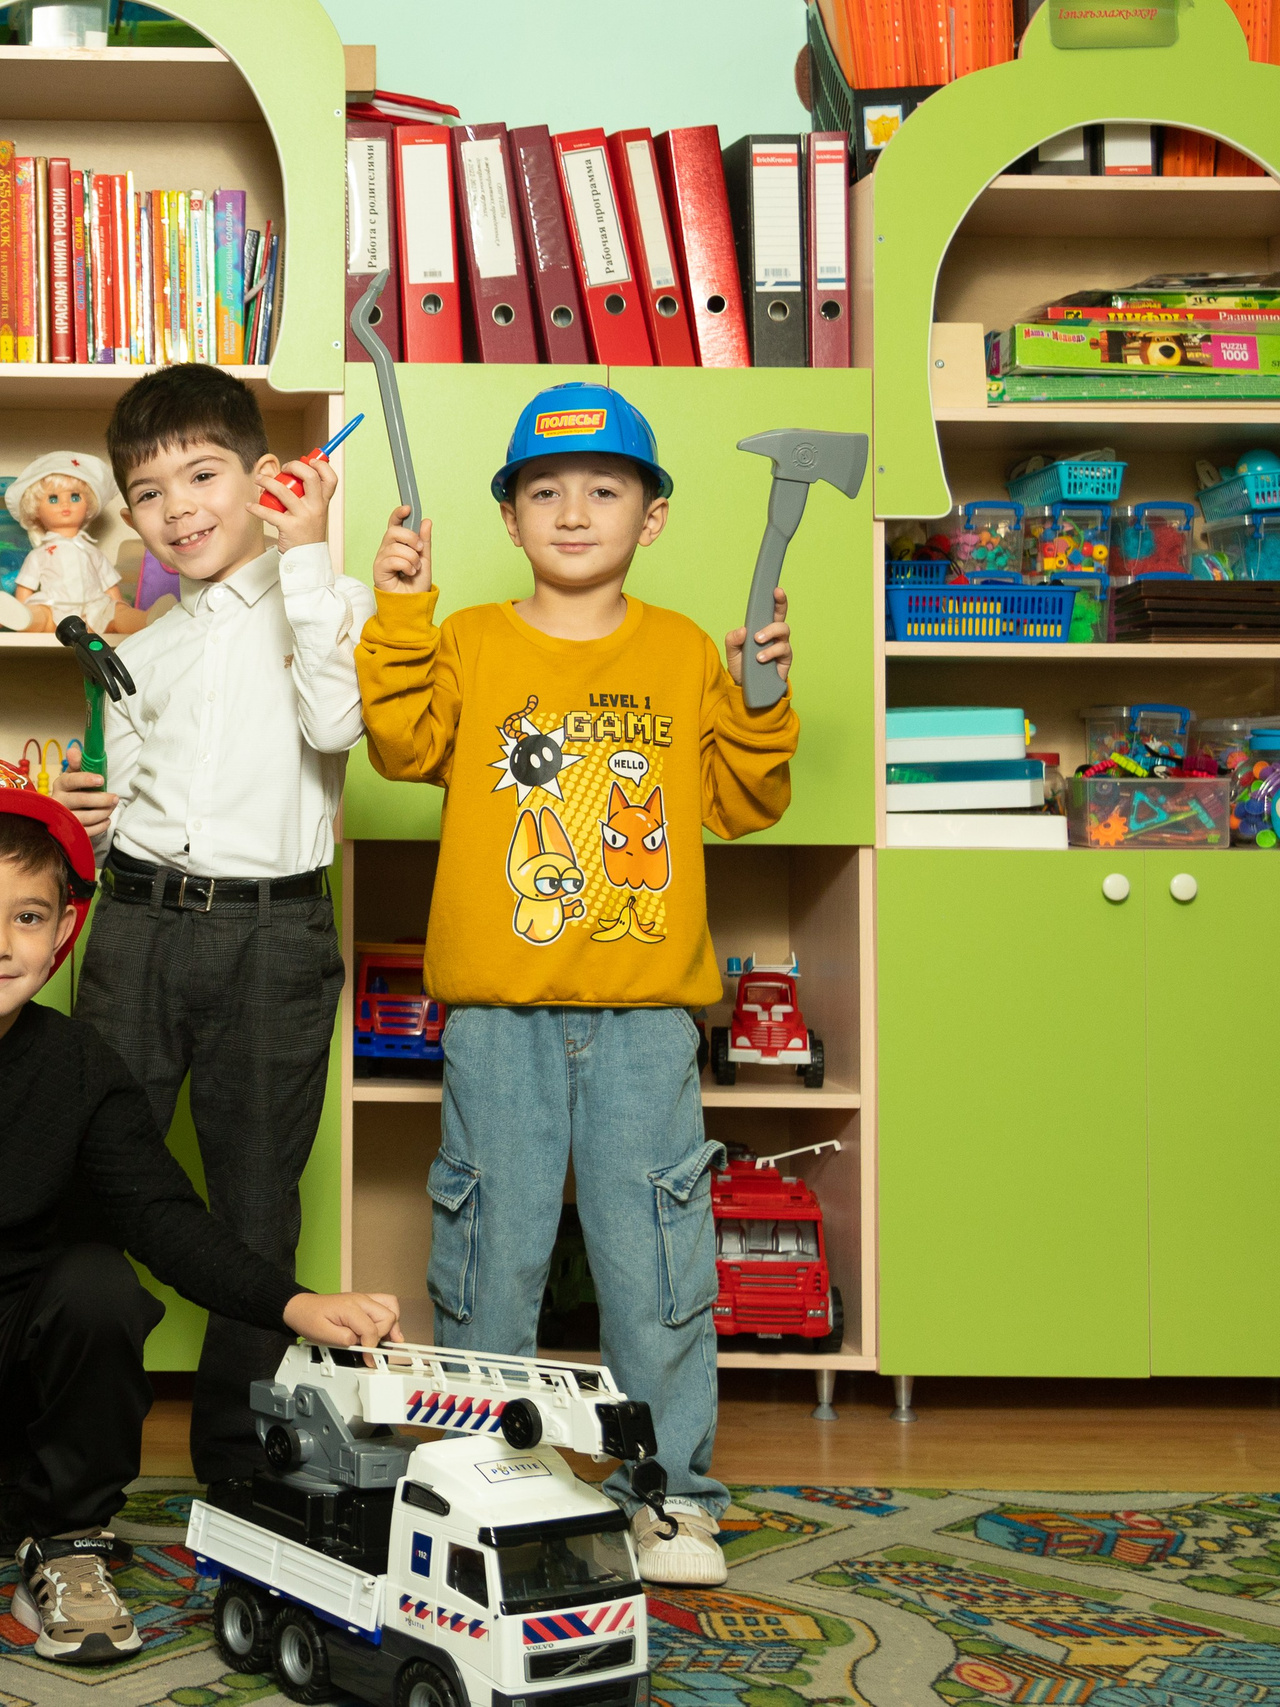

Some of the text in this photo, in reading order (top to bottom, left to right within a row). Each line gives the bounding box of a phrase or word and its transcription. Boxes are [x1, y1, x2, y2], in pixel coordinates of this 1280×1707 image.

[756, 156, 792, 164] ErichKrause
[367, 144, 379, 216] родителями
[0, 199, 11, 248] СКАЗОК
[584, 158, 615, 274] Рабочая программа
[0, 250, 8, 262] НА
[225, 201, 234, 300] ДРУЖЕЛЮБНЫЙ СЛОВАРИК
[367, 228, 378, 268] Работа
[53, 187, 69, 334] КРАСНАЯ КНИГА РОССИИ
[0, 265, 10, 301] КРУГЛЫЙ
[0, 303, 9, 319] ГОД
[1023, 328, 1045, 340] Маша
[1051, 330, 1086, 343] Медведь
[1220, 342, 1248, 351] PUZZLE
[1221, 349, 1249, 361] 1000
[540, 413, 601, 430] ПОЛЕСЬЕ
[588, 693, 652, 710] LEVEL 1
[563, 710, 673, 747] GAME
[613, 759, 645, 771] HELLO
[491, 1463, 541, 1476] POLITIE
[73, 1538, 107, 1548] adidas
[525, 1643, 554, 1652] VOLVO
